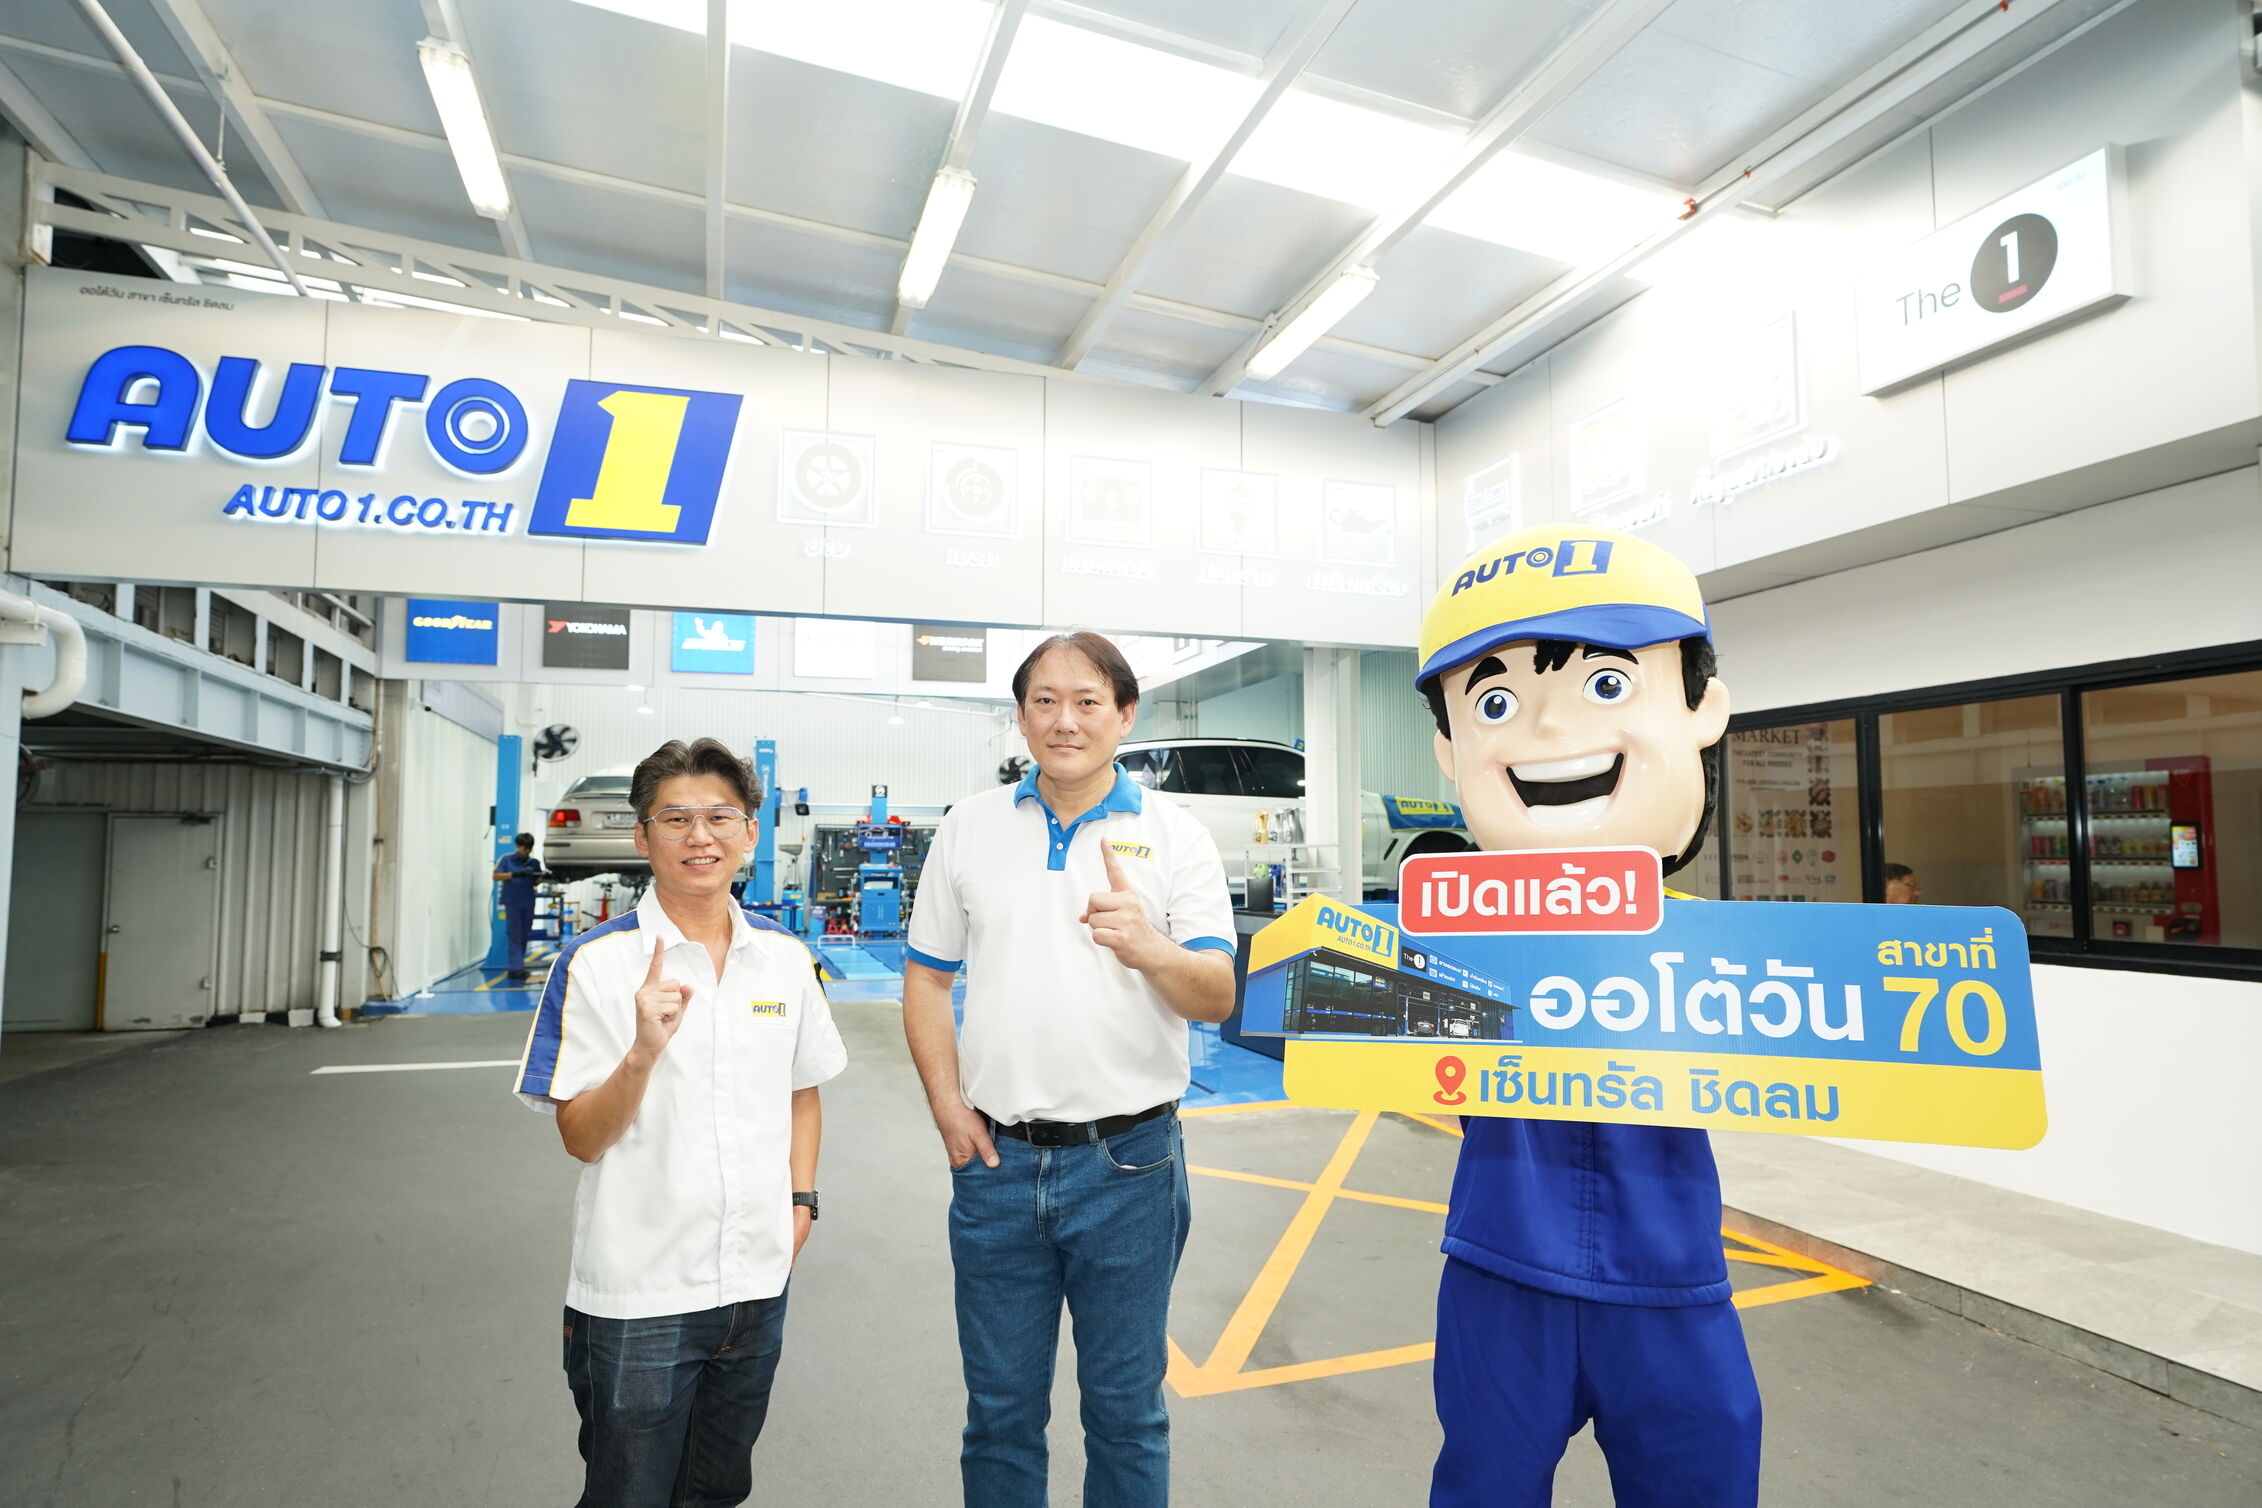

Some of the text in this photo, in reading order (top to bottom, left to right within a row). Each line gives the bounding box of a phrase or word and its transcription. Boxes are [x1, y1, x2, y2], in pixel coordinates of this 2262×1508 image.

[1896, 282, 1961, 326] The
[566, 622, 627, 635] YOKOHAMA
[1732, 729, 1801, 745] MARKET
[1421, 863, 1638, 917] เปิดแล้ว!
[1877, 927, 1996, 969] สาขาที่
[1529, 951, 1865, 1041] ออโต้วัน
[1883, 976, 2007, 1056] 70
[1480, 1054, 1840, 1121] เซ็นทรัล ชิดลม
